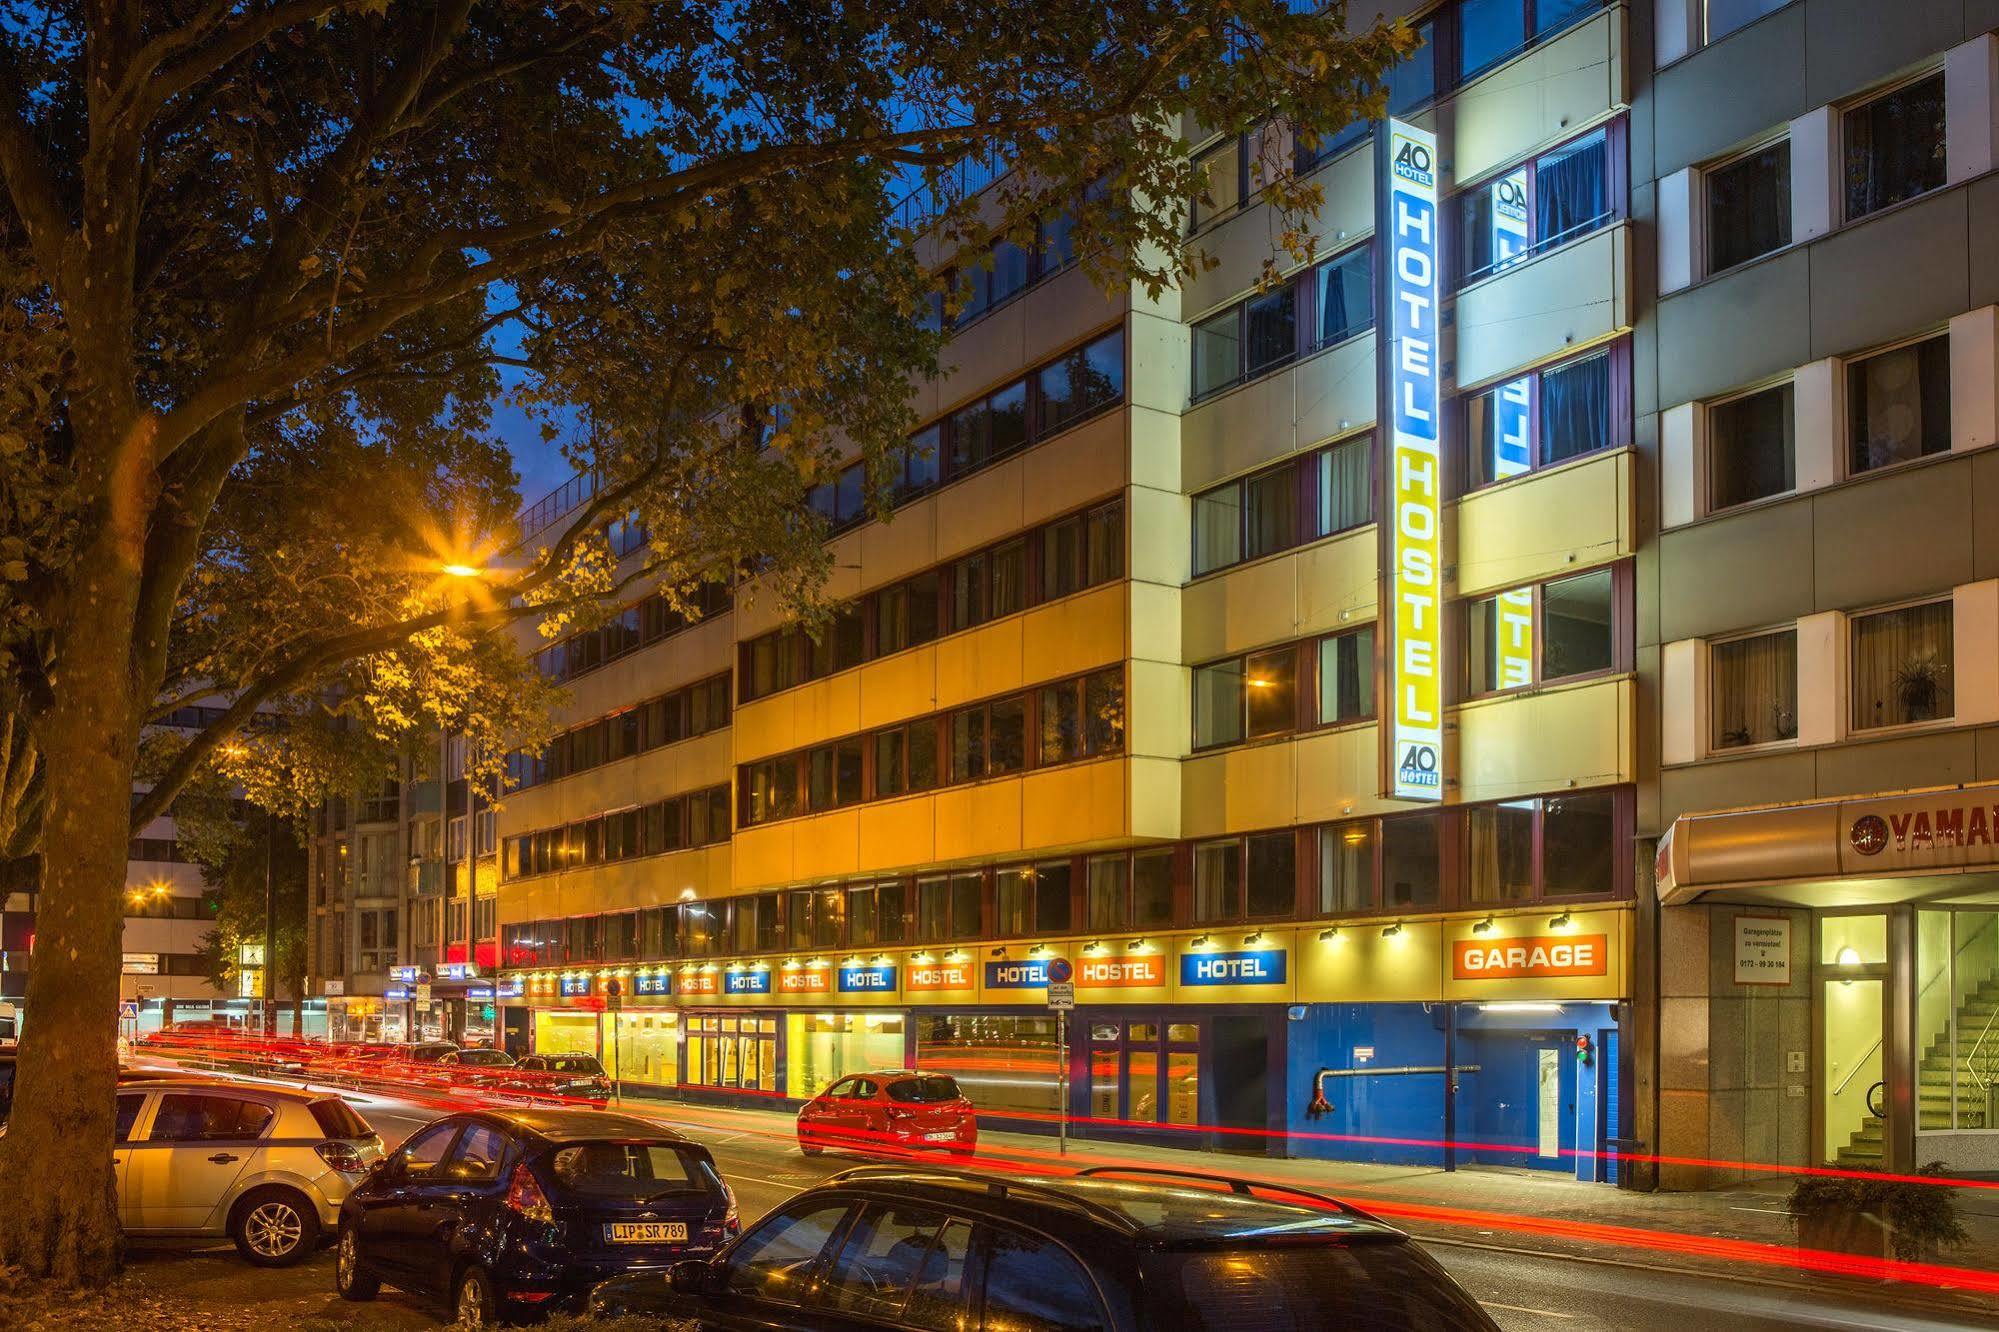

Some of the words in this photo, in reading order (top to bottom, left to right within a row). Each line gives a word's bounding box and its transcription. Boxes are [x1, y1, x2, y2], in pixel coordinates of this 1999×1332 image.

[1395, 142, 1431, 172] AO
[1396, 163, 1432, 186] HOTEL
[1398, 200, 1431, 422] HOTEL
[1400, 456, 1434, 723] HOSTEL
[1401, 745, 1436, 771] AO
[1400, 769, 1437, 785] HOSTEL
[1464, 944, 1593, 970] GARAGE
[912, 969, 966, 984] HOSTEL
[997, 966, 1048, 982] HOTEL
[1083, 962, 1155, 981] HOSTEL
[1197, 959, 1267, 978] HOTEL
[564, 982, 585, 993] HOTEL
[640, 979, 665, 991] HOTEL
[681, 977, 713, 990] HOSTEL
[732, 976, 762, 989] HOTEL
[782, 974, 824, 988] HOSTEL
[847, 972, 886, 987] HOTEL
[613, 1225, 635, 1239] LIP
[645, 1224, 660, 1238] SR
[663, 1224, 684, 1238] 789
